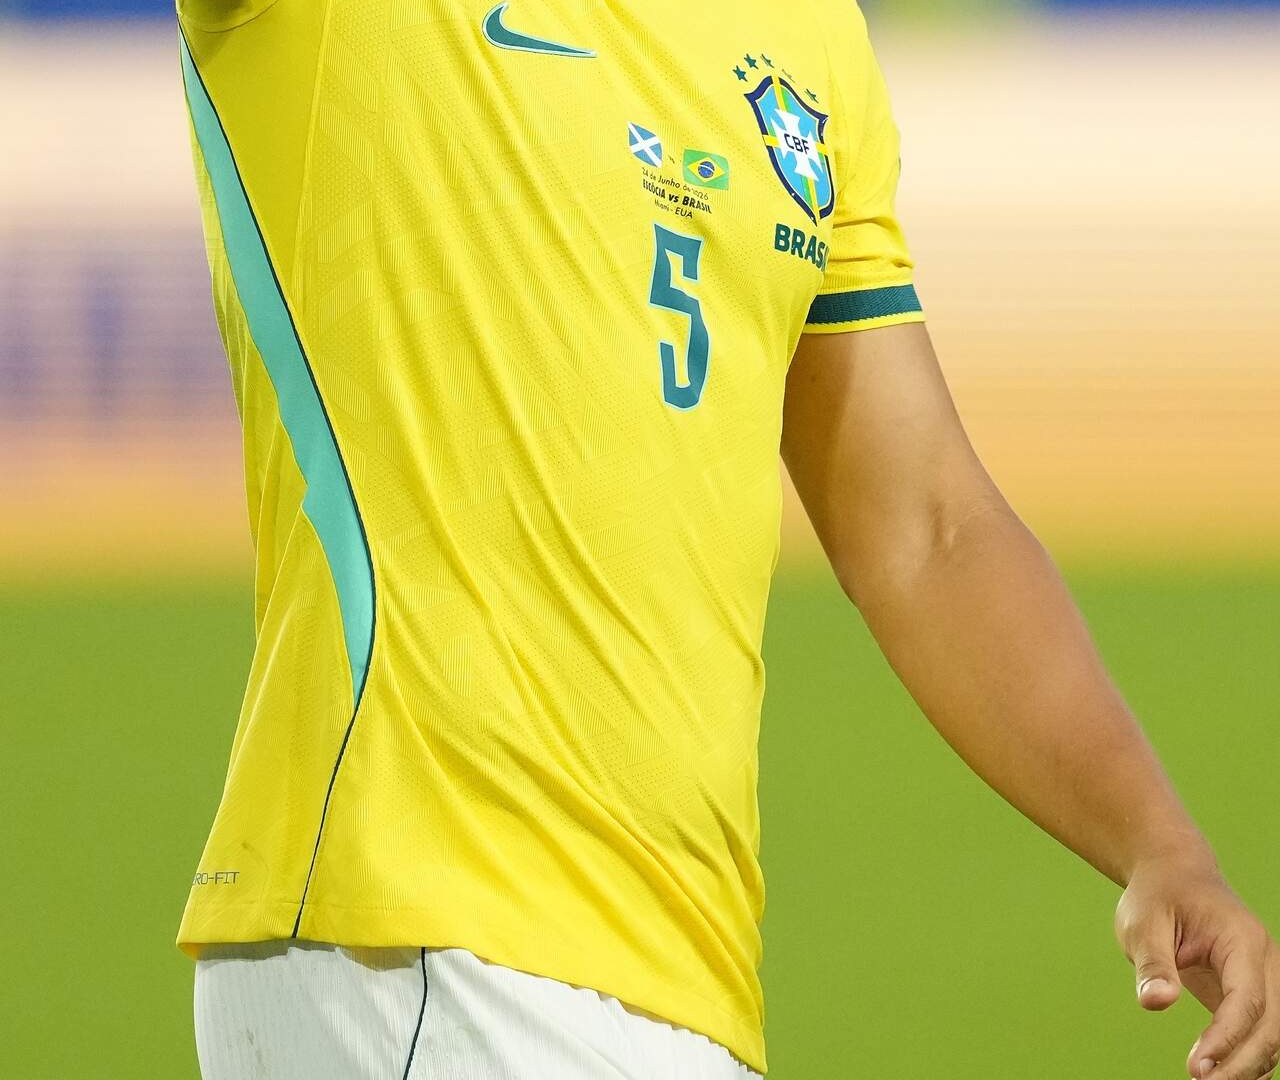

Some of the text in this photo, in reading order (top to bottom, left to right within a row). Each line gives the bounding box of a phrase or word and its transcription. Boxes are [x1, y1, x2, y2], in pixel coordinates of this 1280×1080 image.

[784, 133, 810, 155] CBF
[658, 175, 681, 189] Junho
[668, 193, 679, 203] vs
[682, 195, 712, 214] BRASIL
[675, 207, 693, 219] EUA
[650, 223, 709, 409] 5
